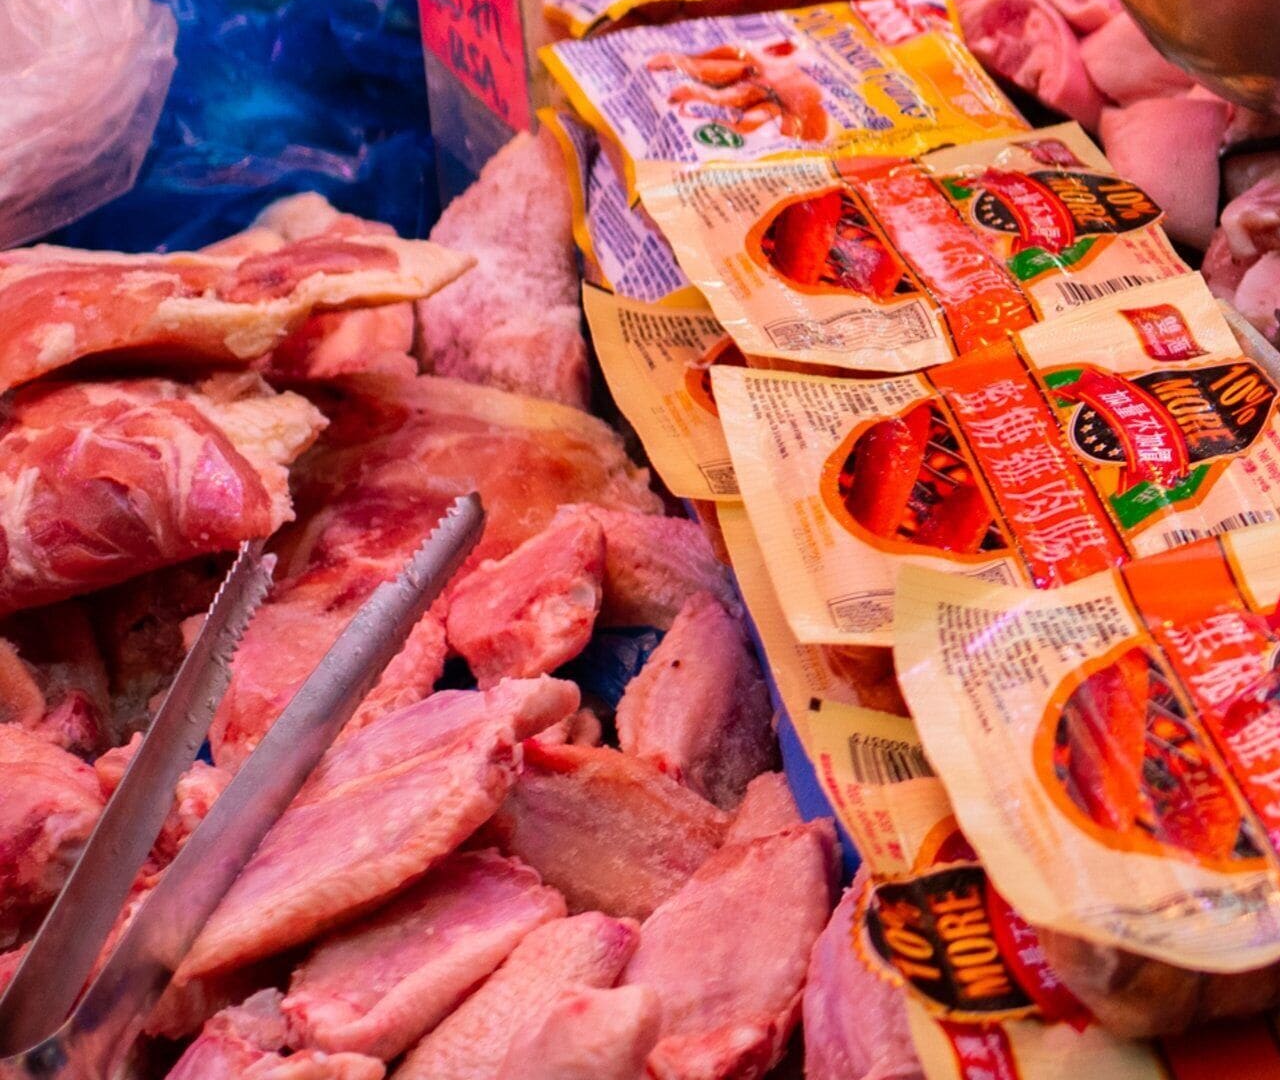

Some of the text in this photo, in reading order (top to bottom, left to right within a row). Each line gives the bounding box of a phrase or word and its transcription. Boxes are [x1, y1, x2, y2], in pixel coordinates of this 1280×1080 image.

[1098, 389, 1173, 463] 加量不加價
[1150, 377, 1236, 448] MORE
[1209, 365, 1272, 425] 10%
[950, 376, 1107, 560] 蜜糖雞肉腸
[928, 884, 1010, 999] MORE
